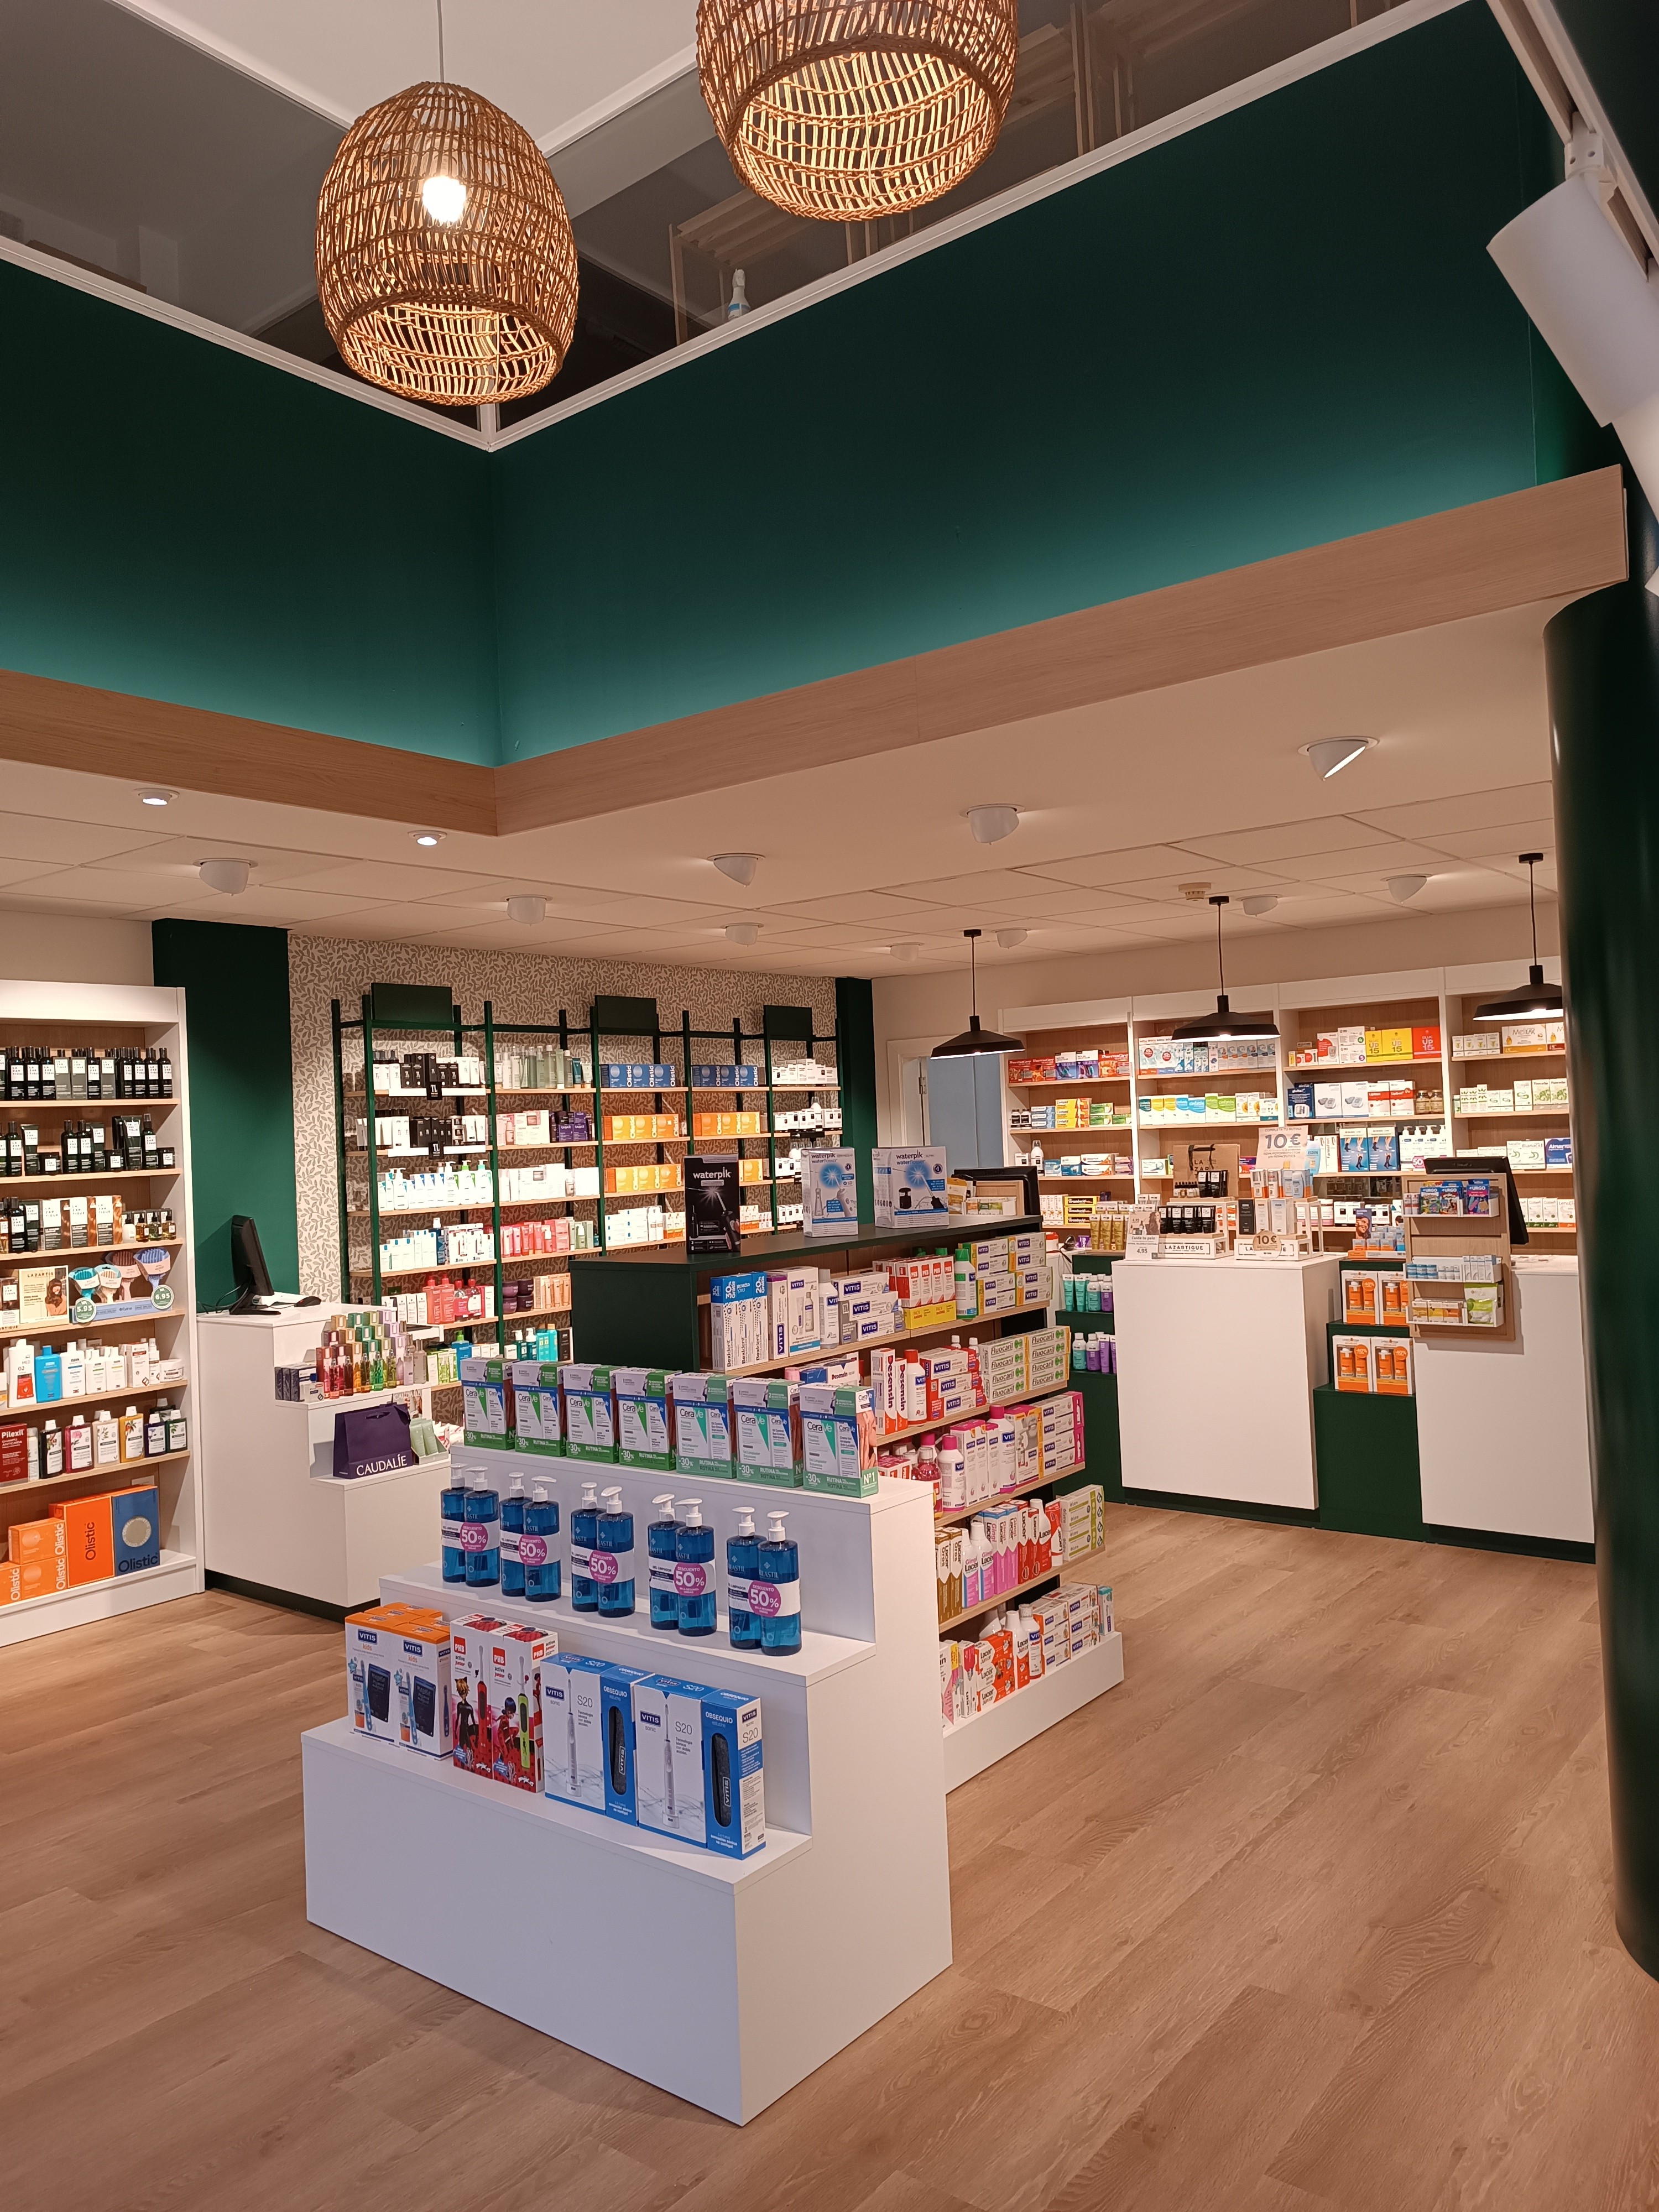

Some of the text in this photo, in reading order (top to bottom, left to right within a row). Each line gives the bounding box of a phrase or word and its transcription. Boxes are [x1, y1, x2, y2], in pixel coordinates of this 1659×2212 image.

[896, 1149, 924, 1160] waterpik
[693, 1166, 731, 1180] waterpik
[845, 1284, 860, 1293] VITIS
[853, 1304, 869, 1313] VITIS
[862, 1324, 877, 1333] VITIS
[1032, 1333, 1055, 1344] Fluocaril
[991, 1343, 1013, 1355] Fluocaril
[1032, 1346, 1055, 1358] Fluocaril
[935, 1363, 950, 1371] VITIS
[992, 1357, 1014, 1369] Fluocaril
[1032, 1360, 1053, 1371] Fluocaril
[992, 1371, 1014, 1383] Fluocaril
[1032, 1374, 1054, 1385] Fluocaril
[942, 1381, 956, 1390] VITIS
[466, 1389, 484, 1397] CeraVe
[993, 1385, 1014, 1398] Fluocaril
[518, 1393, 539, 1403] CeraVe
[570, 1397, 590, 1407] CeraVe
[947, 1399, 961, 1408] VITIS
[622, 1403, 644, 1413] CeraVe
[680, 1408, 704, 1418] CeraVe
[740, 1414, 765, 1425] CeraVe
[807, 1421, 833, 1433] CeraVe
[1, 1428, 25, 1438] Pilexil
[55, 1522, 64, 1556] Olistic
[85, 1521, 96, 1561] Olistic
[461, 1530, 487, 1544] 50%
[520, 1542, 545, 1557] 50%
[118, 1553, 159, 1573] Olistic
[591, 1558, 617, 1575] 50%
[56, 1557, 66, 1590] Olistic
[675, 1571, 705, 1587] 50%
[11, 1567, 20, 1601] Olistic
[750, 1588, 779, 1608] 50%
[359, 1632, 376, 1642] VITIS
[404, 1644, 421, 1653] VITIS
[455, 1643, 465, 1652] PHB
[494, 1655, 505, 1663] PHB
[533, 1650, 543, 1658] PHB
[547, 1689, 563, 1698] VITIS
[603, 1686, 628, 1698] OBSEQUIO
[577, 1694, 593, 1708] S20
[641, 1714, 659, 1724] VITIS
[705, 1711, 733, 1725] OBSEQUIO
[743, 1710, 757, 1721] VITIS
[645, 1725, 656, 1734] sonic
[675, 1720, 693, 1735] S20
[742, 1726, 759, 1744] S20
